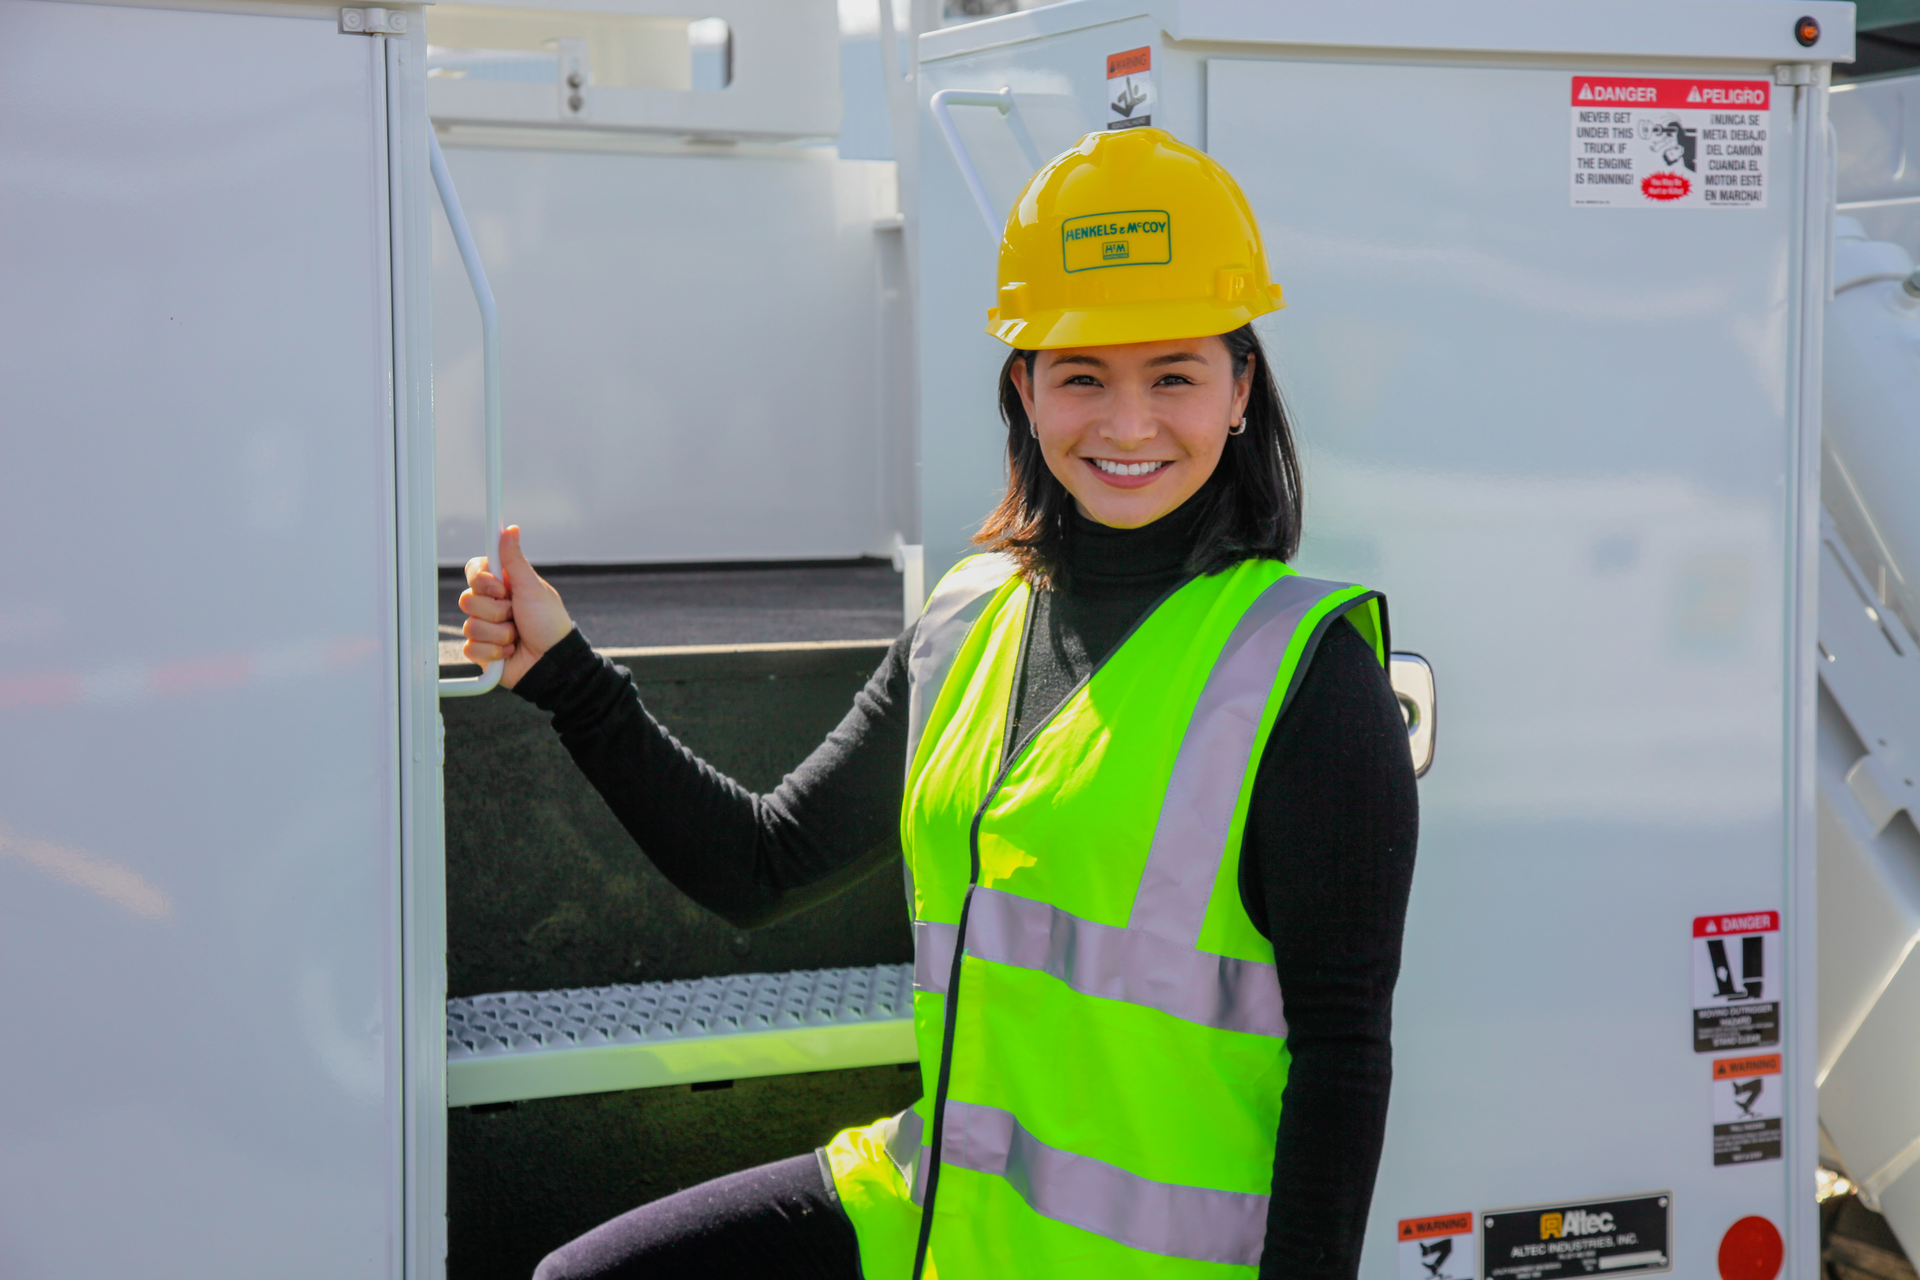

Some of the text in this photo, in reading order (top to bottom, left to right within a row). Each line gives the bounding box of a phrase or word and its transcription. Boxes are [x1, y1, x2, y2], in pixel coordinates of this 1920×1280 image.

[1115, 53, 1147, 70] WARNING
[1594, 86, 1657, 102] DANGER
[1702, 88, 1765, 105] PELIGRO
[1579, 111, 1632, 123] NEVER GET
[1748, 114, 1761, 126] SE
[1577, 126, 1634, 139] UNDER THIS
[1702, 129, 1767, 141] META DEBAJO
[1584, 142, 1627, 154] TRUCK IF
[1706, 142, 1763, 156] DEL CAMIÓN
[1577, 157, 1633, 170] THE ENGINE
[1708, 160, 1760, 171] CUANDA EL
[1575, 173, 1634, 185] IS RUNNING!
[1705, 173, 1763, 187] MOTOR ESTÉ
[1705, 190, 1762, 202] EN MARCHA!
[1065, 223, 1118, 242] HENKELS
[1721, 914, 1771, 932] DANGER
[1719, 1015, 1753, 1026] HAZARD
[1729, 1058, 1777, 1072] WARNING
[1416, 1217, 1468, 1233] WARNING
[1561, 1210, 1616, 1237] Altec
[1510, 1243, 1547, 1258] ALTEC
[1548, 1235, 1615, 1254] INDUSTRIES,
[1616, 1232, 1639, 1246] INC.
